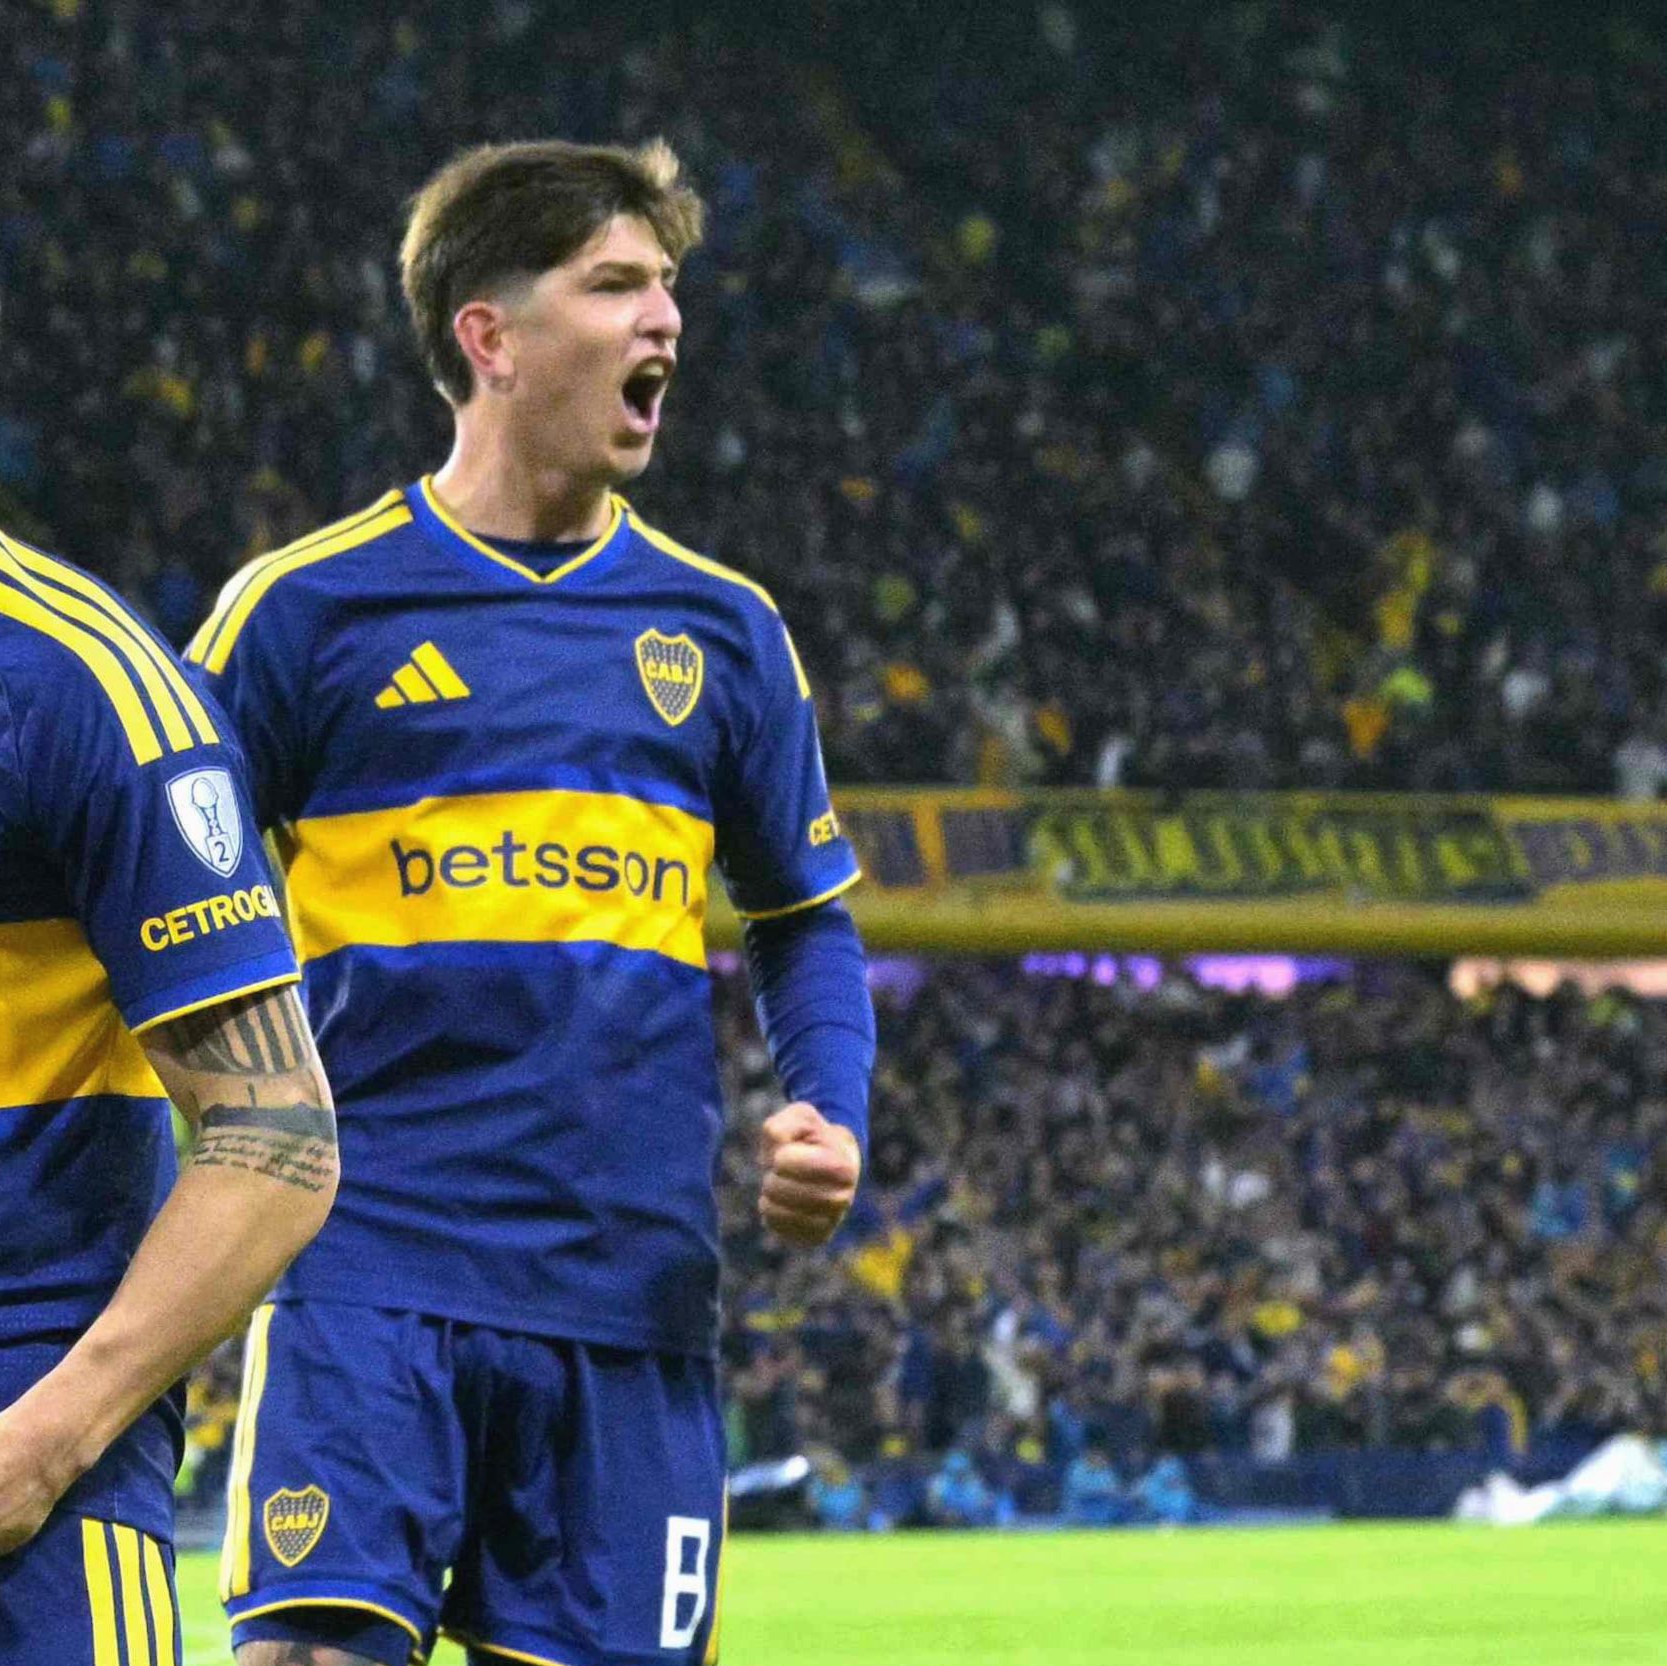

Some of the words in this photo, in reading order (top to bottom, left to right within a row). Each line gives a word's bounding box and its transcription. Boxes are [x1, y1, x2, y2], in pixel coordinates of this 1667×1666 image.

[646, 660, 694, 684] CABJ
[214, 841, 230, 863] 2
[390, 830, 689, 907] betsson
[271, 1512, 320, 1531] CABJ
